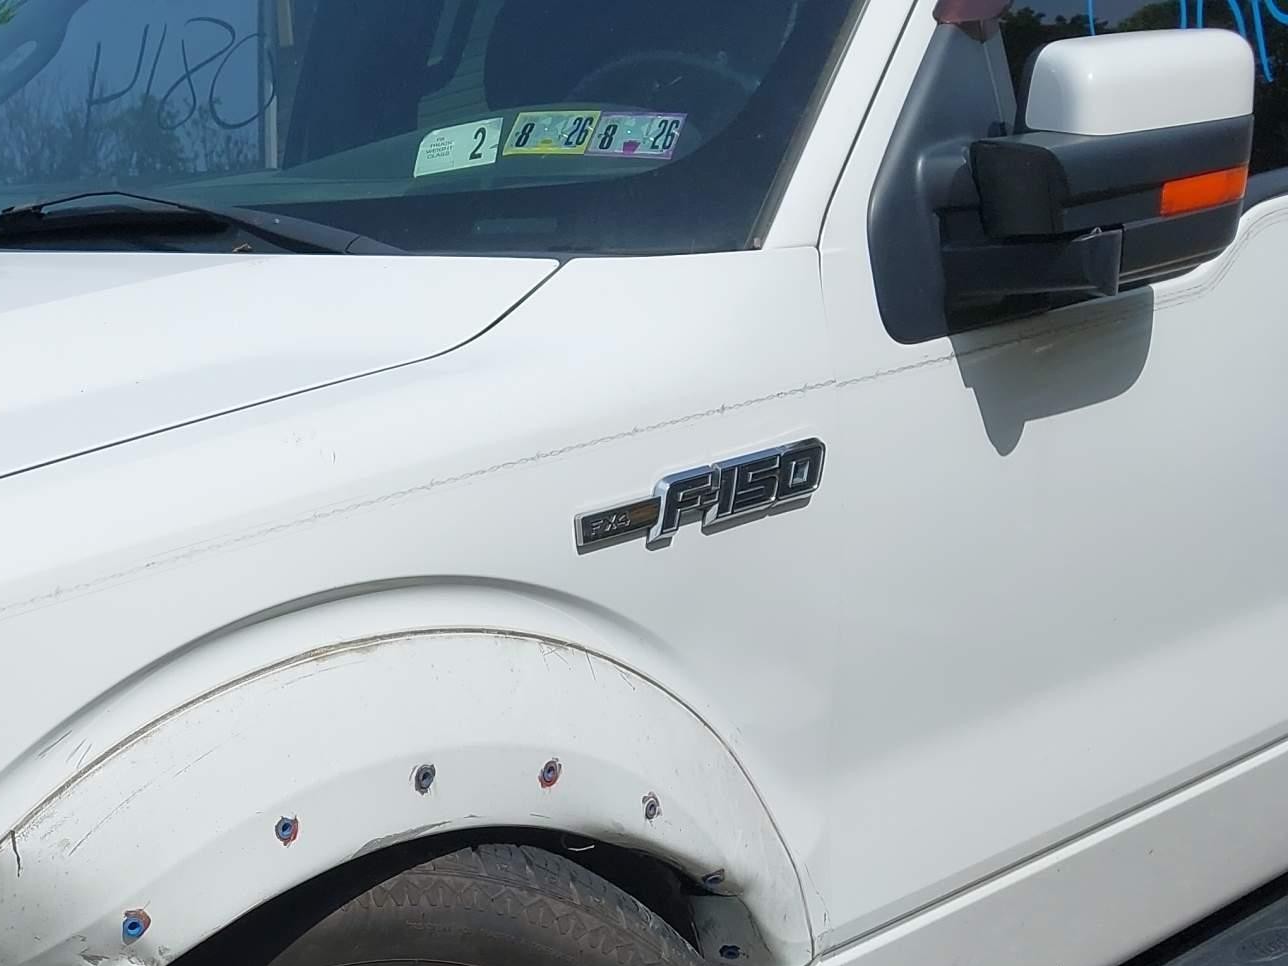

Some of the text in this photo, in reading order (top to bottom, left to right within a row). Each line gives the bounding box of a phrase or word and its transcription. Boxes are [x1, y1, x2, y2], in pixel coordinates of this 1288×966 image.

[468, 127, 487, 160] 2
[515, 117, 594, 147] 8 26
[598, 119, 680, 150] 8 26
[589, 511, 632, 538] FX4
